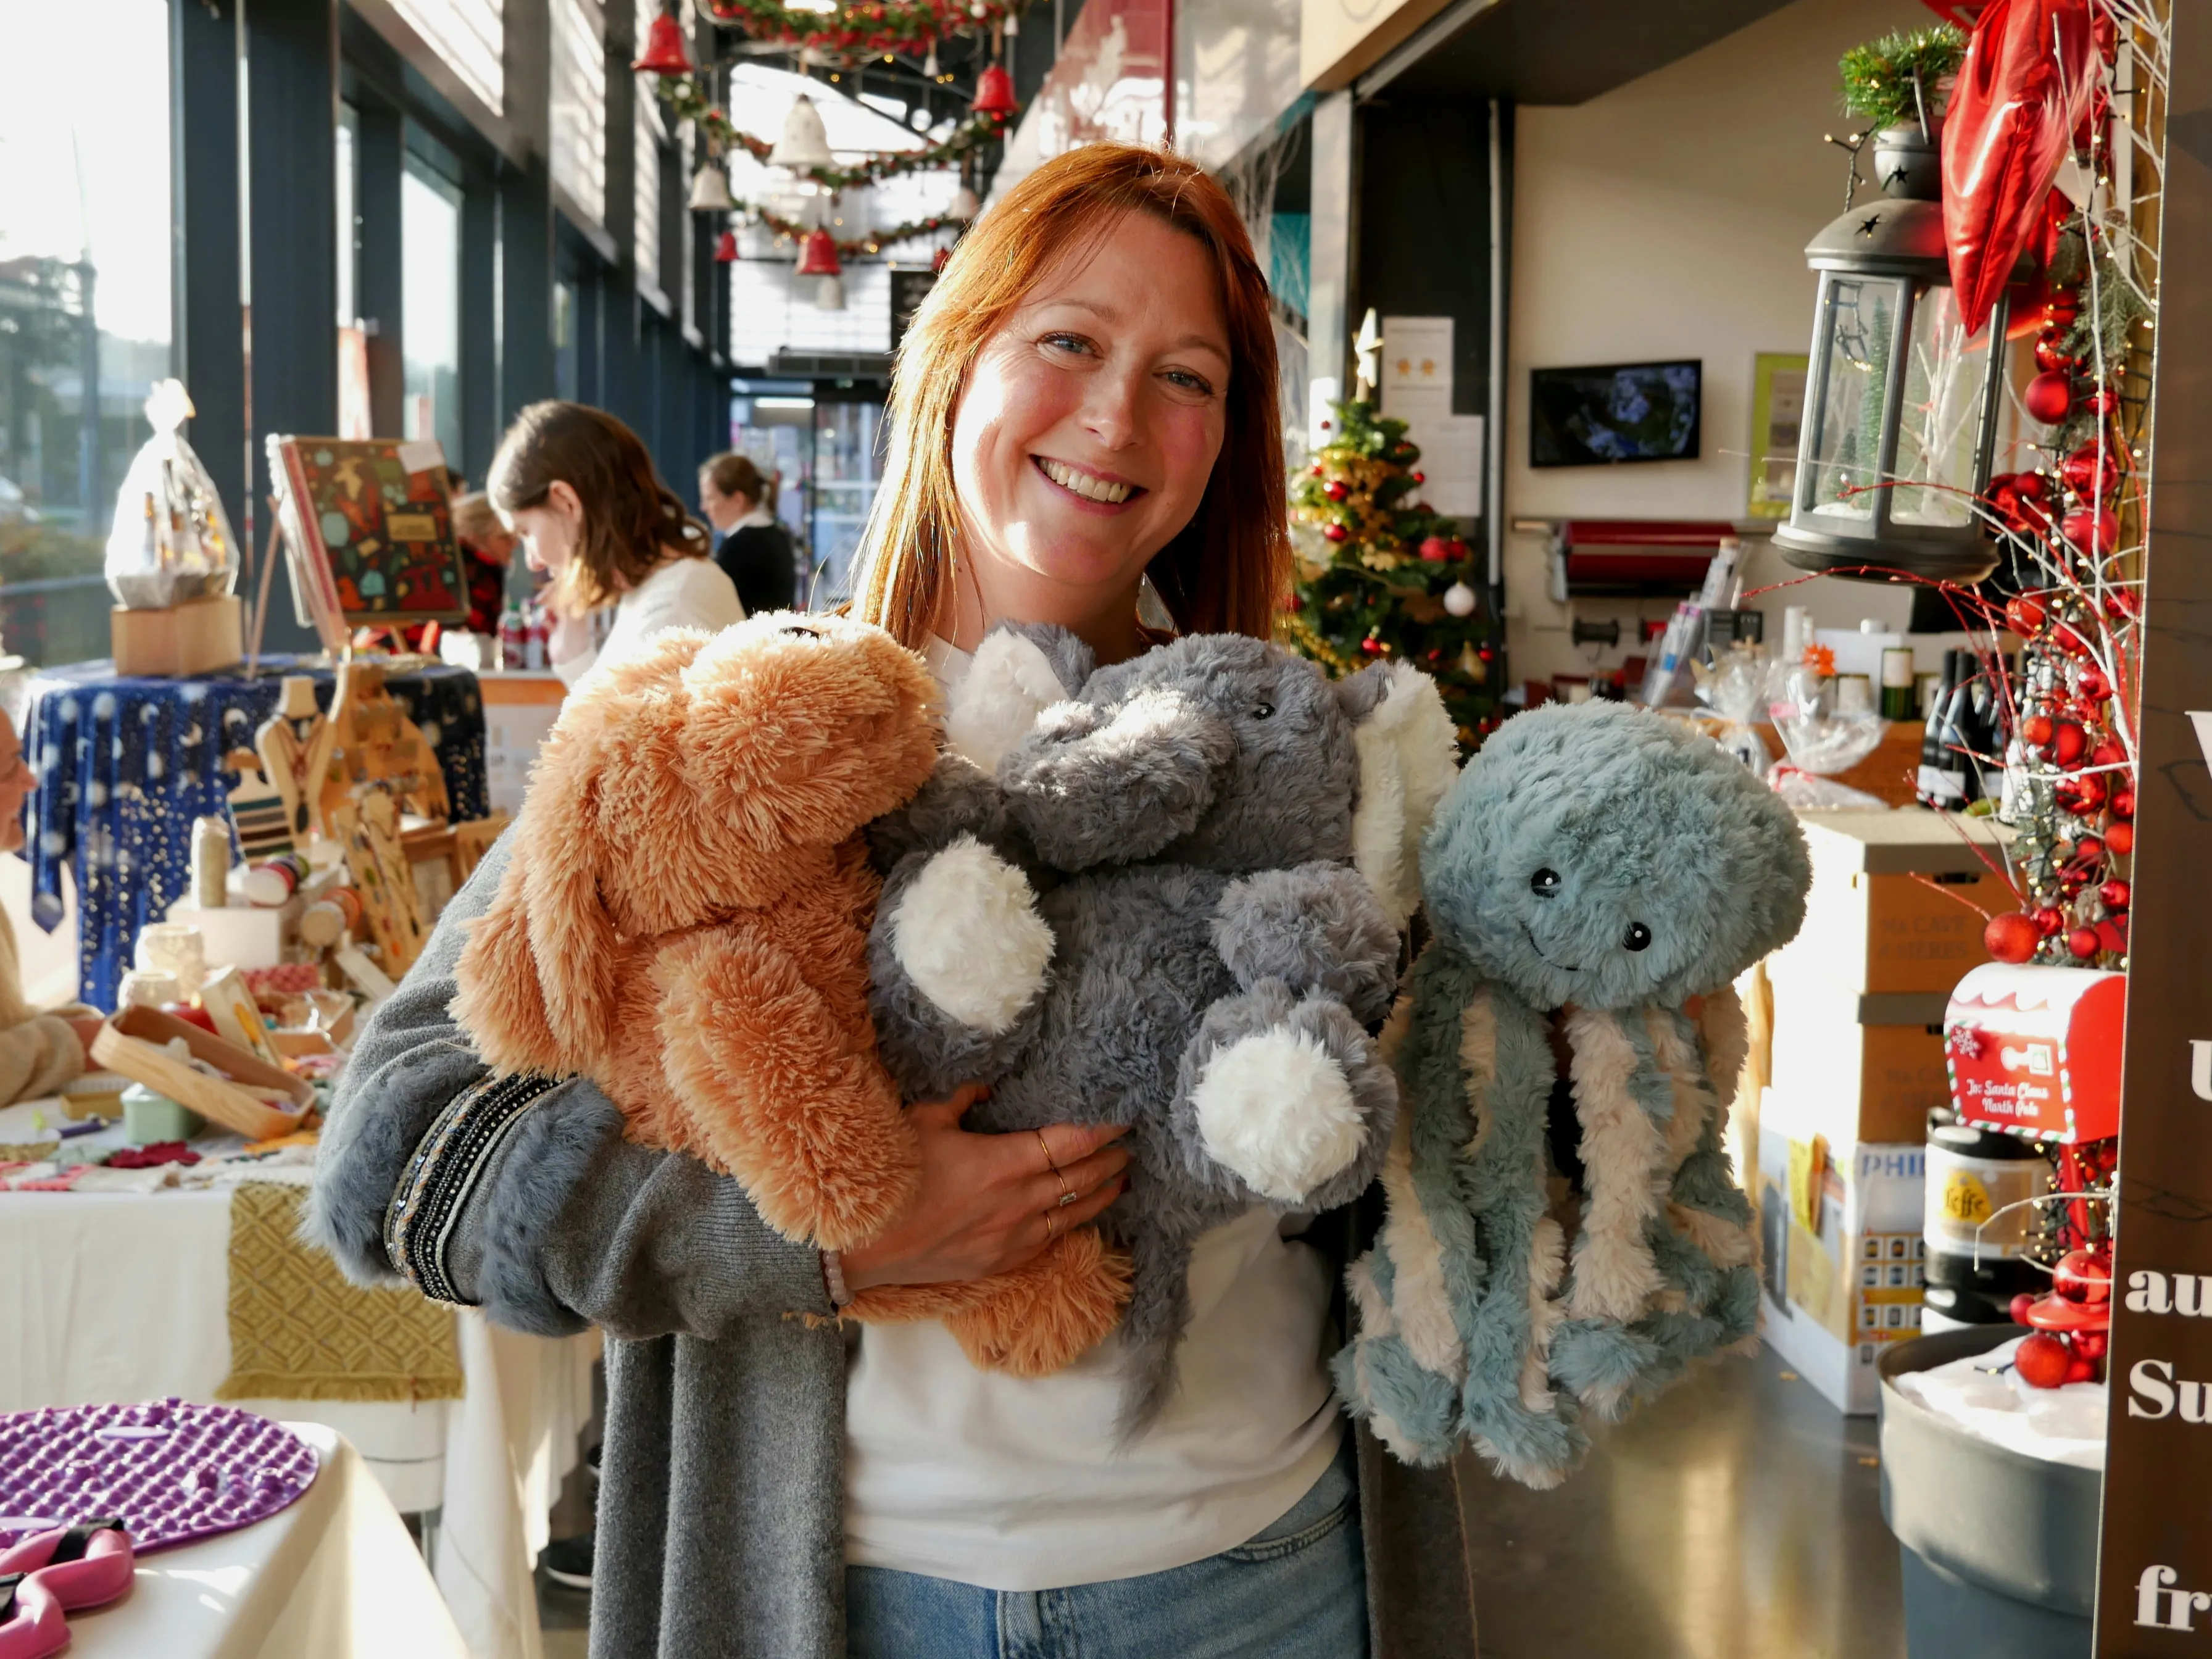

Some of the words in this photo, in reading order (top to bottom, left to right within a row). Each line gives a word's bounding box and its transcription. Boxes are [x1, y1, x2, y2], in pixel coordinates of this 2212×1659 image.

[1984, 1079, 2016, 1097] Santa
[2017, 1082, 2049, 1099] Claus
[1982, 1097, 2014, 1115] North
[2015, 1100, 2039, 1118] Pole
[1862, 1153, 1925, 1177] PHI
